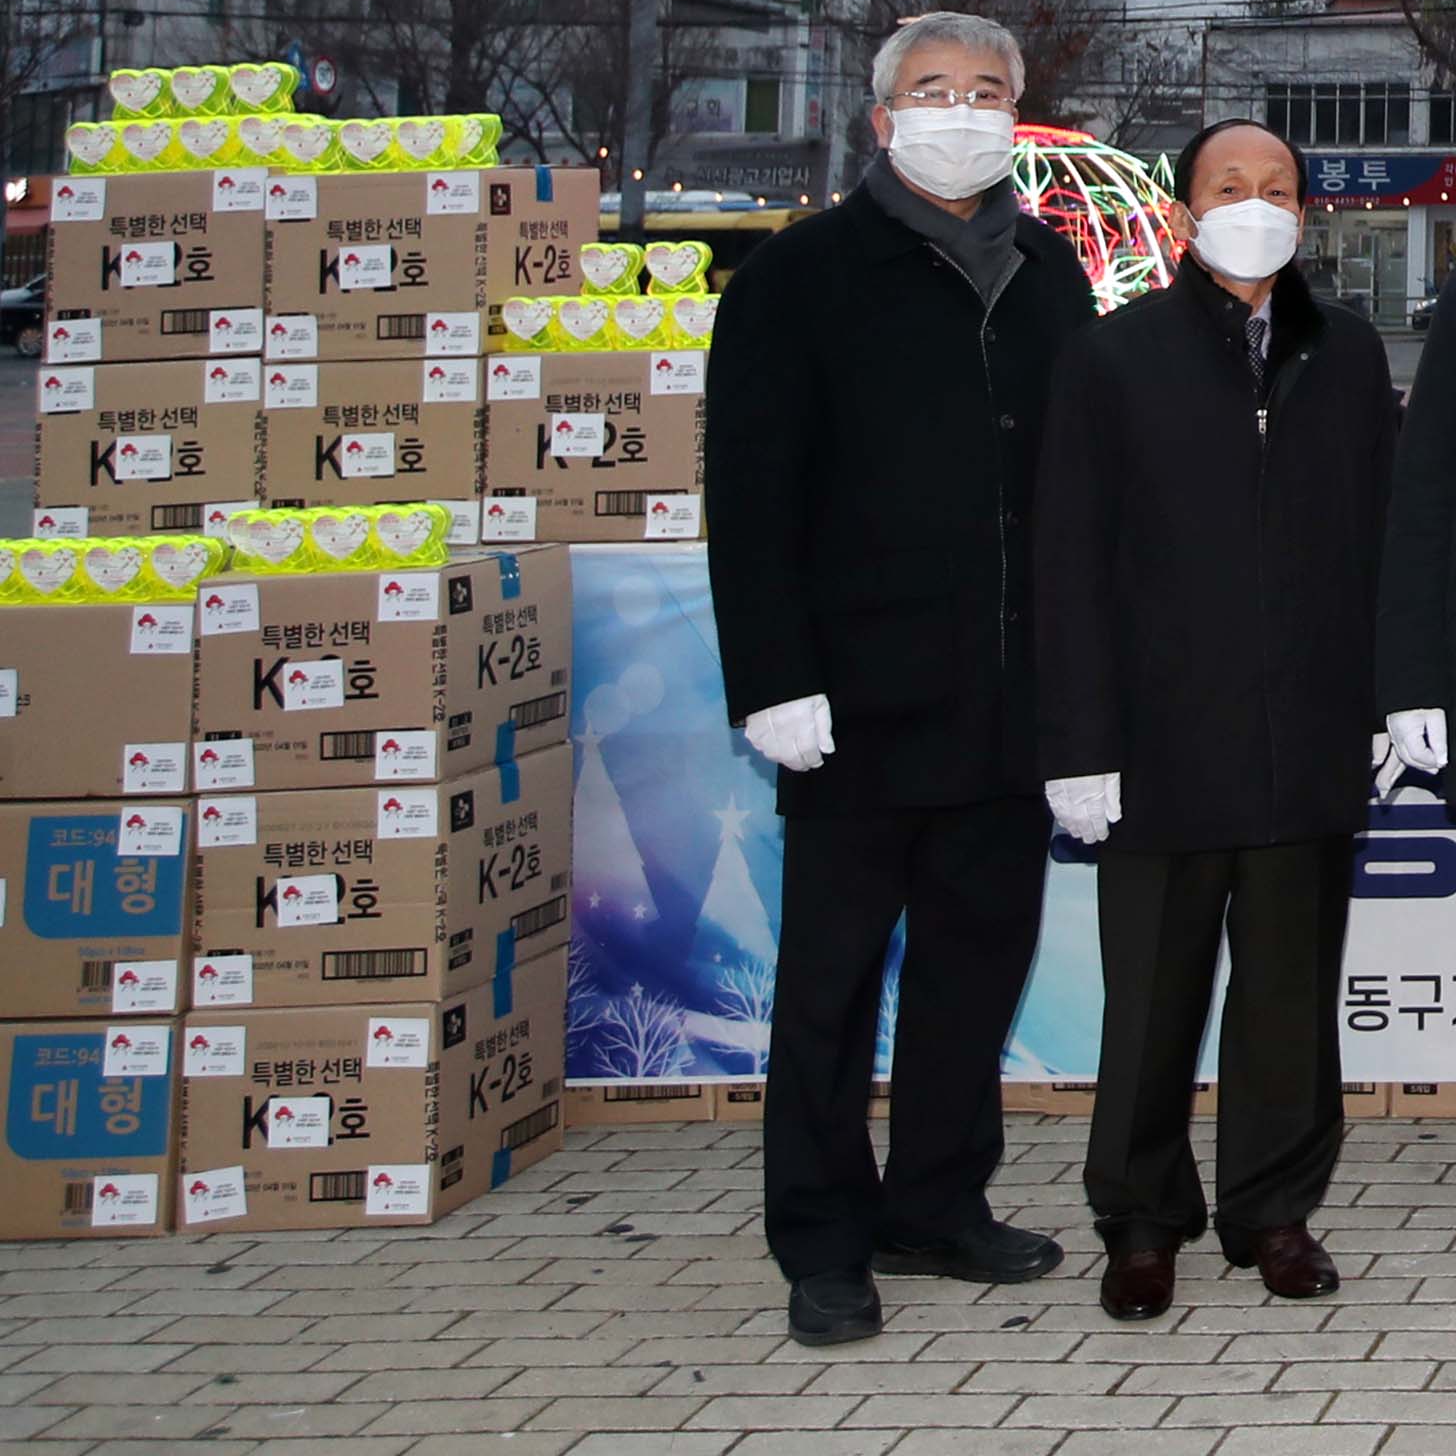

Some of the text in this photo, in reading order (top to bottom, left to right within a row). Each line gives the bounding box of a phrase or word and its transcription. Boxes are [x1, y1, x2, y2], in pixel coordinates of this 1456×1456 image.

[1318, 160, 1390, 191] 봉투
[110, 212, 207, 237] 특별한 선택
[327, 217, 422, 241] 특별한 선택
[515, 245, 571, 286] K-2호
[98, 406, 198, 433] 특별한 선택
[323, 403, 419, 428] 특별한 선택
[262, 620, 370, 650] 특별한 선택
[478, 634, 542, 689] K-2호
[263, 839, 374, 868] 특별한 선택
[479, 844, 542, 904] K-2호
[252, 1057, 362, 1087] 특별한 선택
[469, 1052, 533, 1120] K-2호
